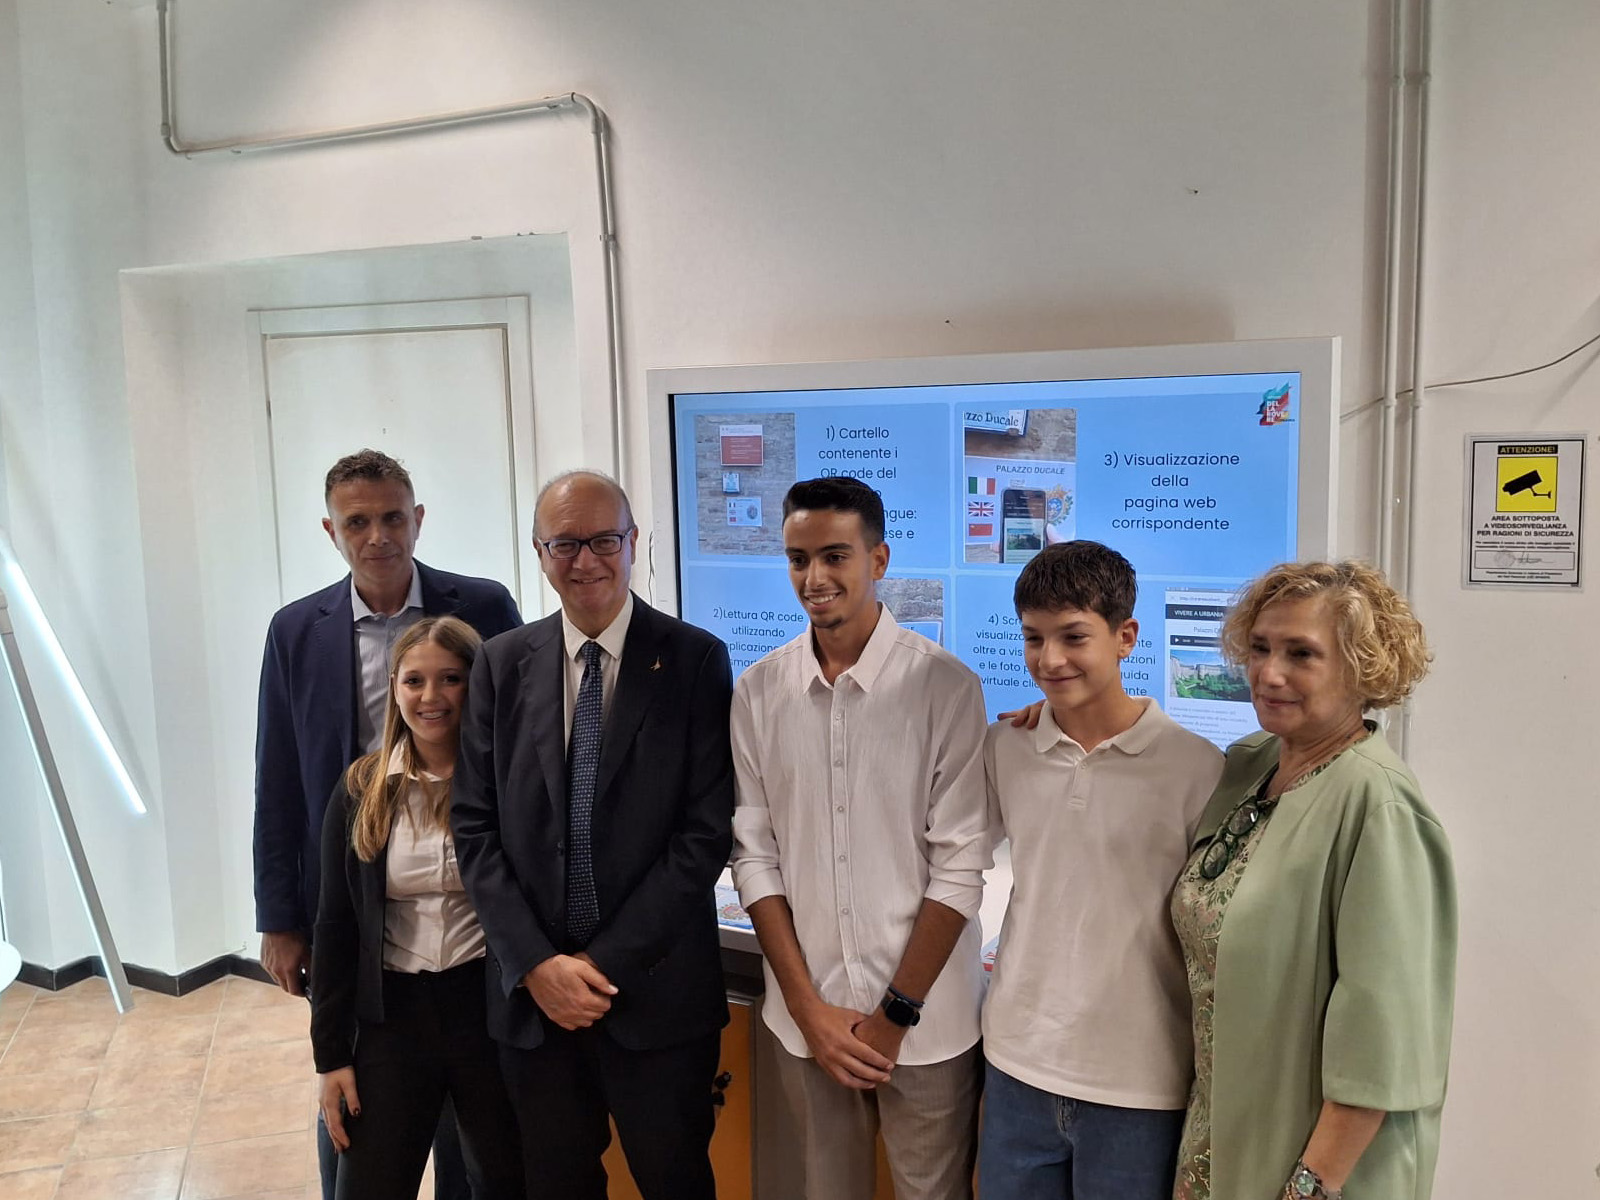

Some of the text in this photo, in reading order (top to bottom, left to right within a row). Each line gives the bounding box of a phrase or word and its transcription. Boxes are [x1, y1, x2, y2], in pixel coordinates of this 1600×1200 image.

[985, 412, 1019, 427] Ducale
[825, 426, 890, 442] 1) Cartello
[818, 447, 898, 460] contenente i
[1103, 451, 1240, 469] 3) Visualizzazione
[841, 467, 873, 479] code
[877, 467, 897, 479] del
[996, 465, 1066, 475] PALAZZO DUCALE
[1151, 474, 1189, 488] della
[1124, 495, 1217, 512] pagina web
[1111, 515, 1230, 534] corrispondente
[906, 530, 915, 539] e
[760, 611, 775, 622] QR
[777, 612, 804, 622] code
[988, 613, 999, 626] 4)
[731, 626, 785, 638] utilizzando
[972, 645, 996, 655] oltre
[998, 647, 1006, 656] a
[978, 662, 986, 670] e
[988, 661, 997, 670] le
[1000, 661, 1021, 672] foto
[981, 676, 1020, 687] virtuale
